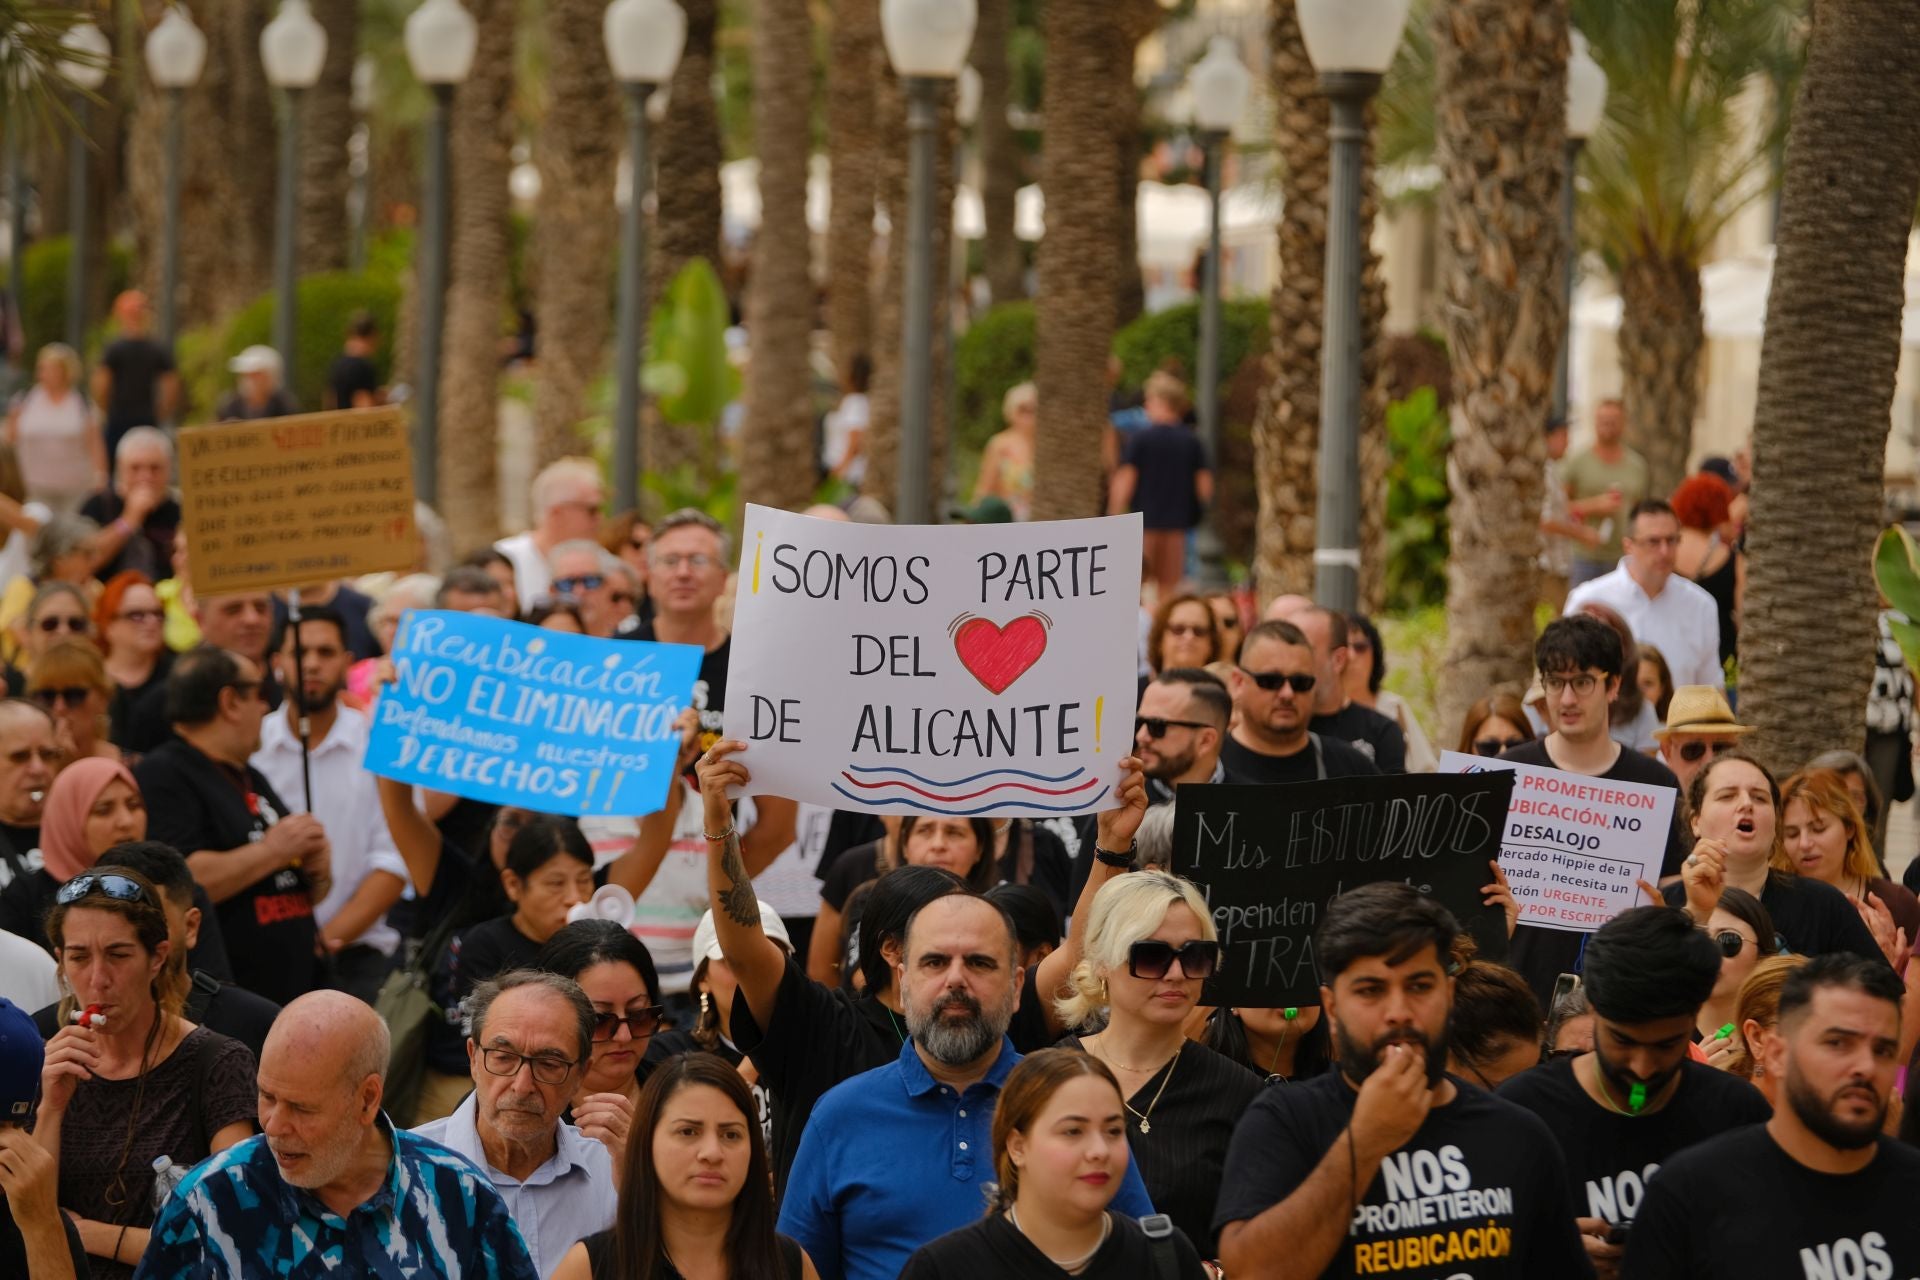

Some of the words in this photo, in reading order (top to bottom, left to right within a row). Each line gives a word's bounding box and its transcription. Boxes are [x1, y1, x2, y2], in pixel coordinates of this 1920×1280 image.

[752, 531, 930, 604] ¡SOMOS
[977, 544, 1108, 603] PARTE
[849, 634, 936, 677] DEL
[390, 656, 456, 704] NO
[381, 699, 519, 753] Defendamos
[536, 741, 649, 772] nuestros
[749, 695, 801, 743] DE
[389, 734, 626, 812] DERECHOS!!
[1522, 775, 1656, 810] PROMETIERON
[1190, 811, 1271, 870] Mis
[1284, 790, 1491, 869] ESTUDIOS
[1510, 823, 1601, 850] DESALOJO
[1551, 873, 1608, 892] necesita
[1611, 883, 1629, 894] un
[1552, 853, 1595, 873] Hippie
[1598, 861, 1616, 875] de
[1618, 865, 1632, 877] la
[1509, 885, 1540, 897] ción
[1529, 904, 1556, 917] POR
[1381, 1144, 1471, 1202] NOS
[1586, 1162, 1661, 1224] NO
[1350, 1186, 1513, 1236] PROMETIERON
[1355, 1219, 1512, 1274] REUBICACIÓN
[1800, 1231, 1894, 1280] NOS
